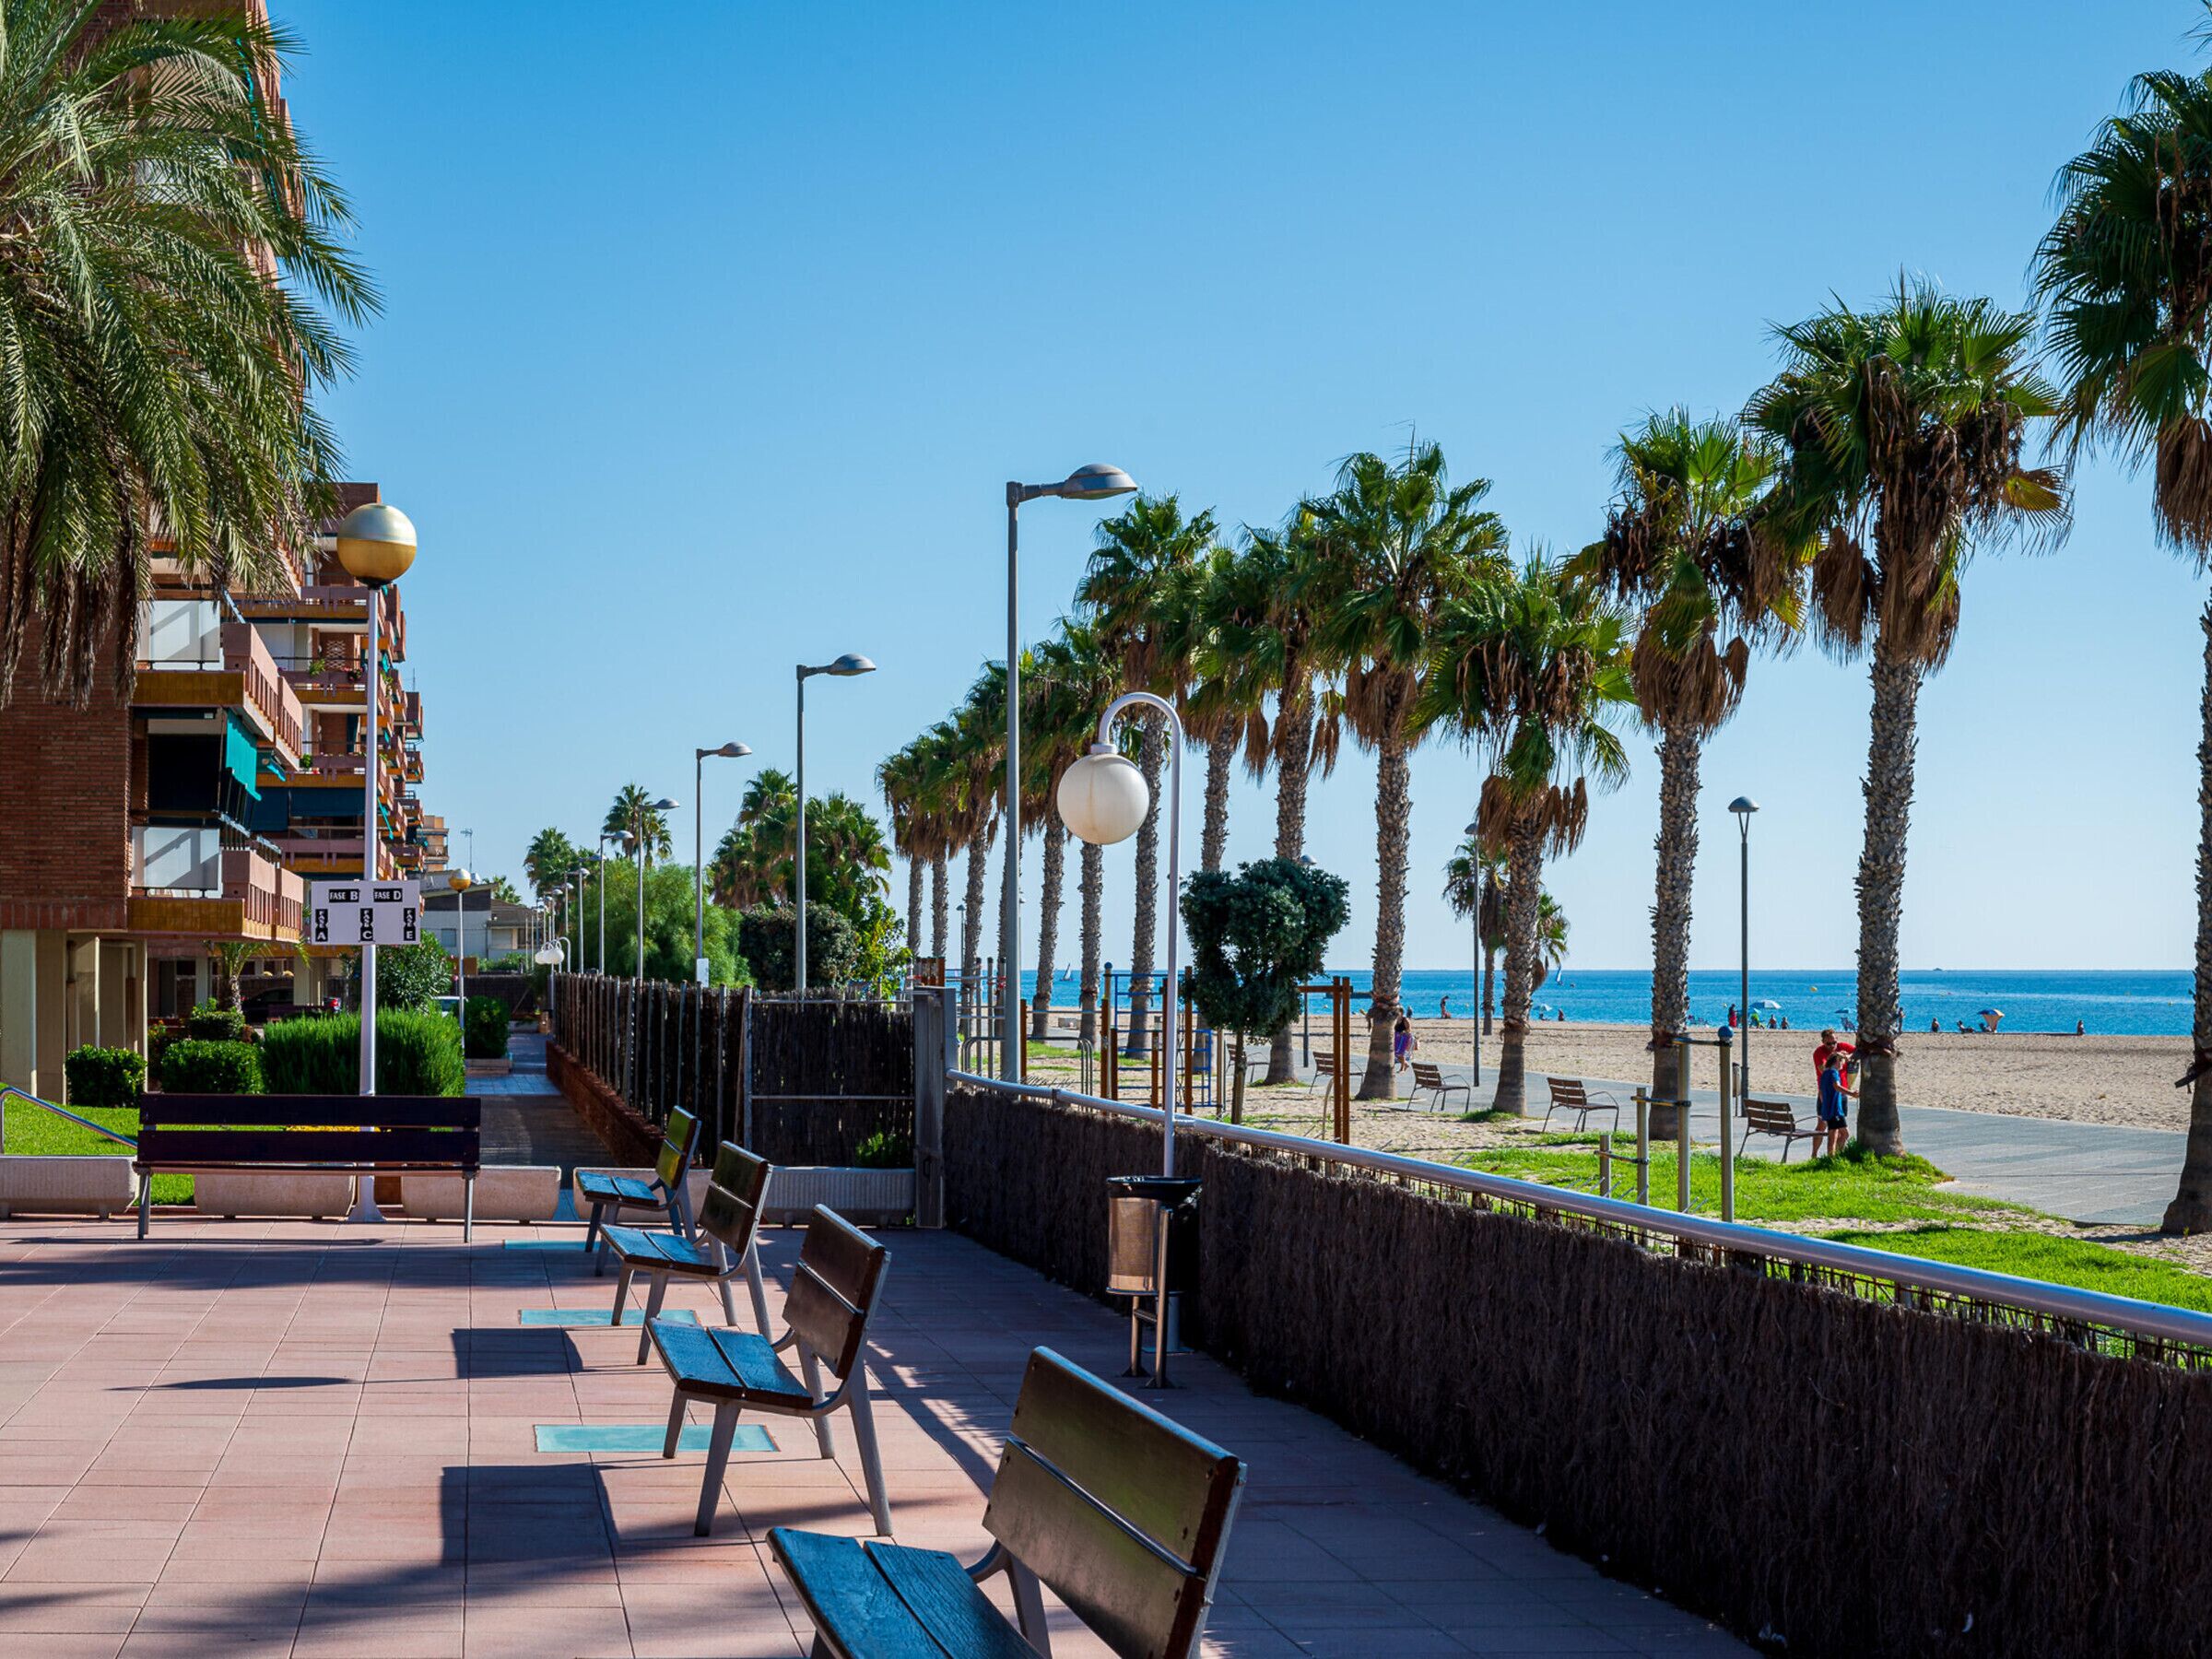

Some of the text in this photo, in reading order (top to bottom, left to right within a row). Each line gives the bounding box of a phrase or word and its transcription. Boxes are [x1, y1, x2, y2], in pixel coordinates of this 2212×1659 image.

[350, 890, 359, 900] B
[374, 890, 402, 900] FASE D
[317, 931, 326, 940] A
[362, 930, 372, 939] C
[406, 930, 413, 939] E
